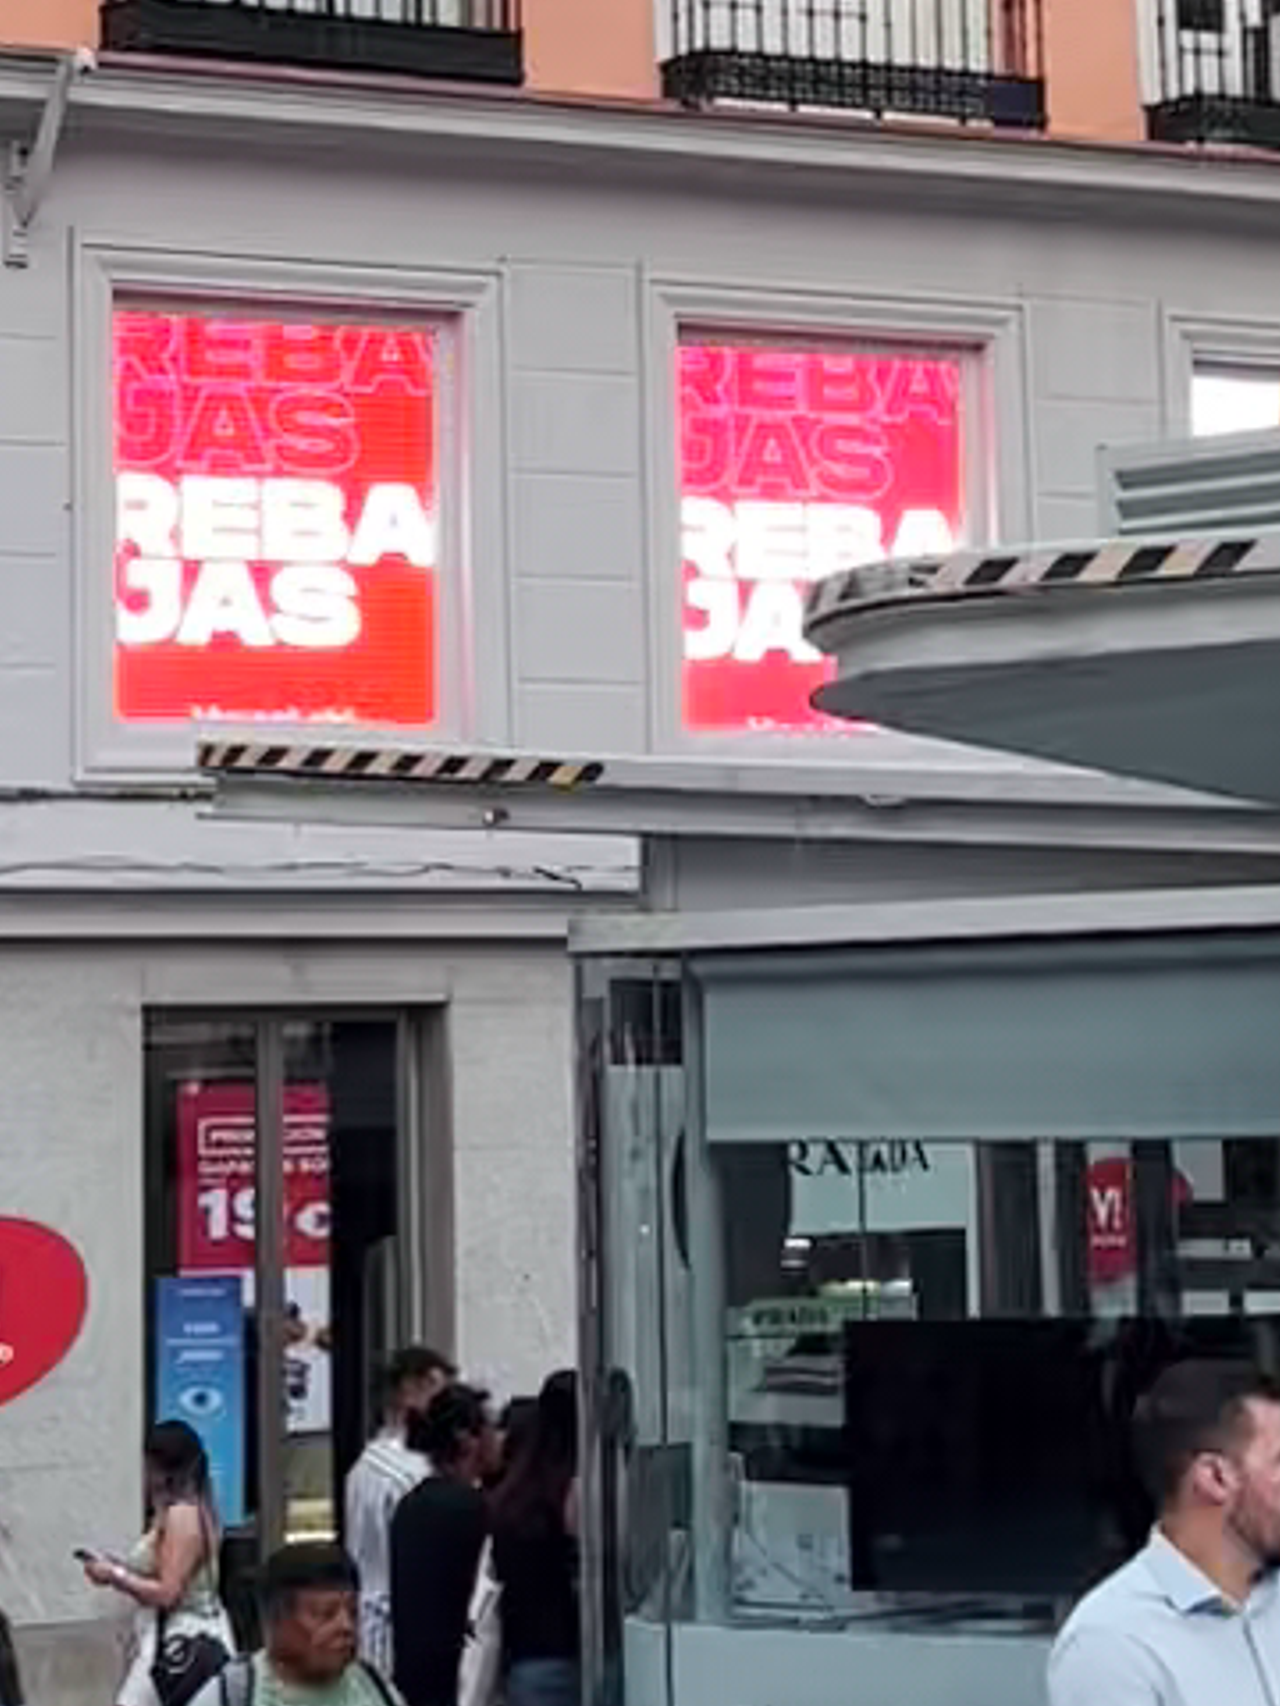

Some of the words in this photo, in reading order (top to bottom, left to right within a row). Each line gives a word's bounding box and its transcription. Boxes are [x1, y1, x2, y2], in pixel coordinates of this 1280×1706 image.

[113, 382, 362, 476] JAS
[680, 411, 894, 503] JAS
[116, 472, 436, 567] REBA
[116, 557, 363, 647] JAS
[683, 578, 825, 664] JA
